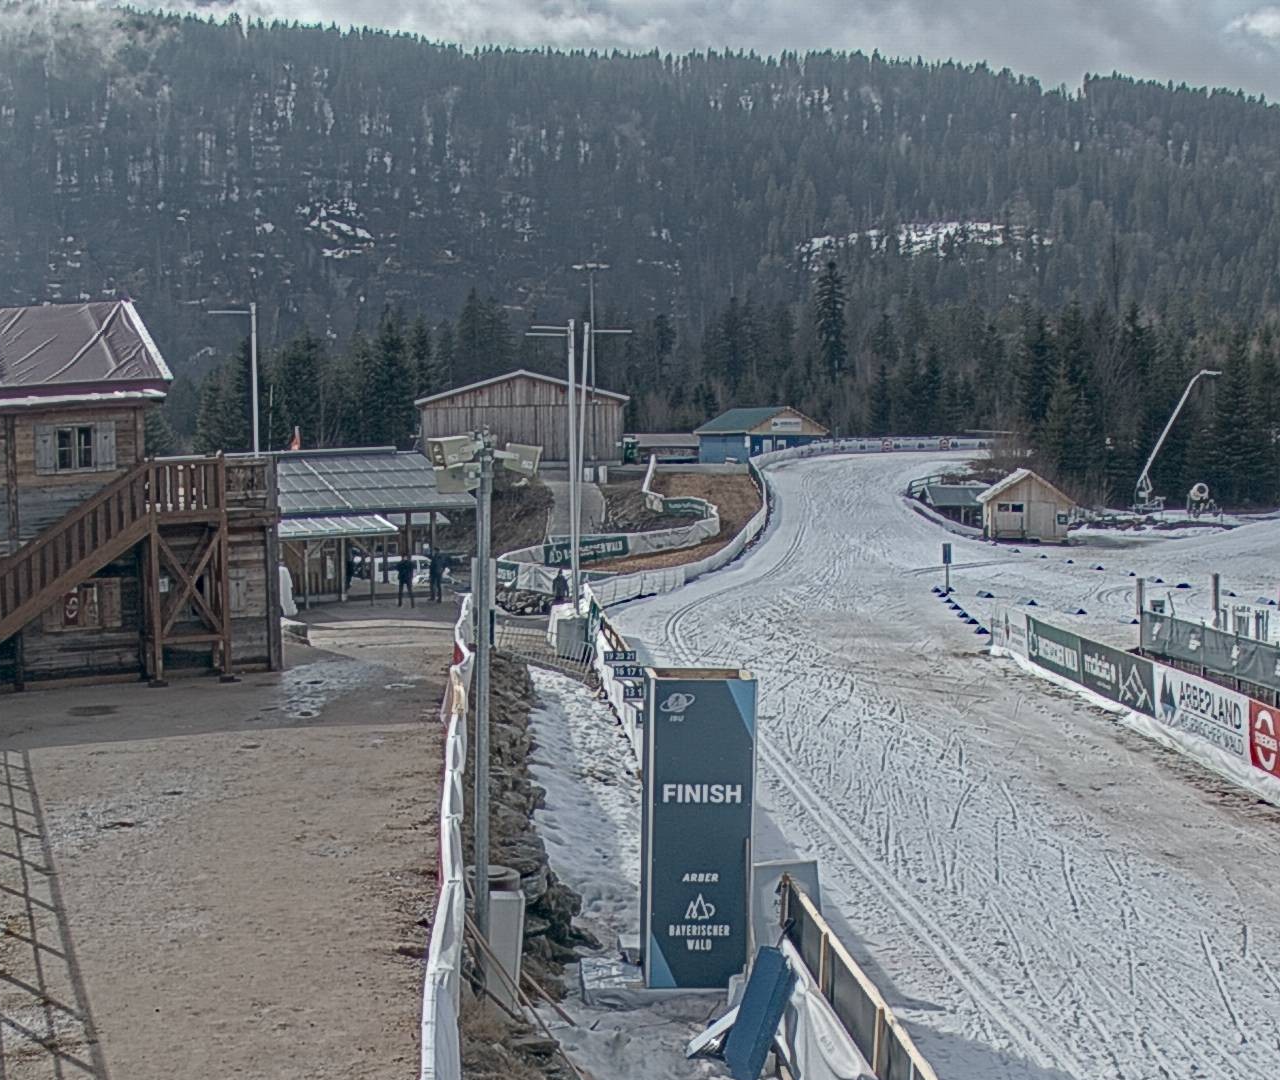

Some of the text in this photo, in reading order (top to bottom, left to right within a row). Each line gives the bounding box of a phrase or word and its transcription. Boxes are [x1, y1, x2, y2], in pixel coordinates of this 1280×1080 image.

[662, 783, 742, 804] FINISH
[681, 872, 719, 883] ARBER
[668, 924, 730, 937] BAYERISCHER
[686, 939, 712, 951] WALD
